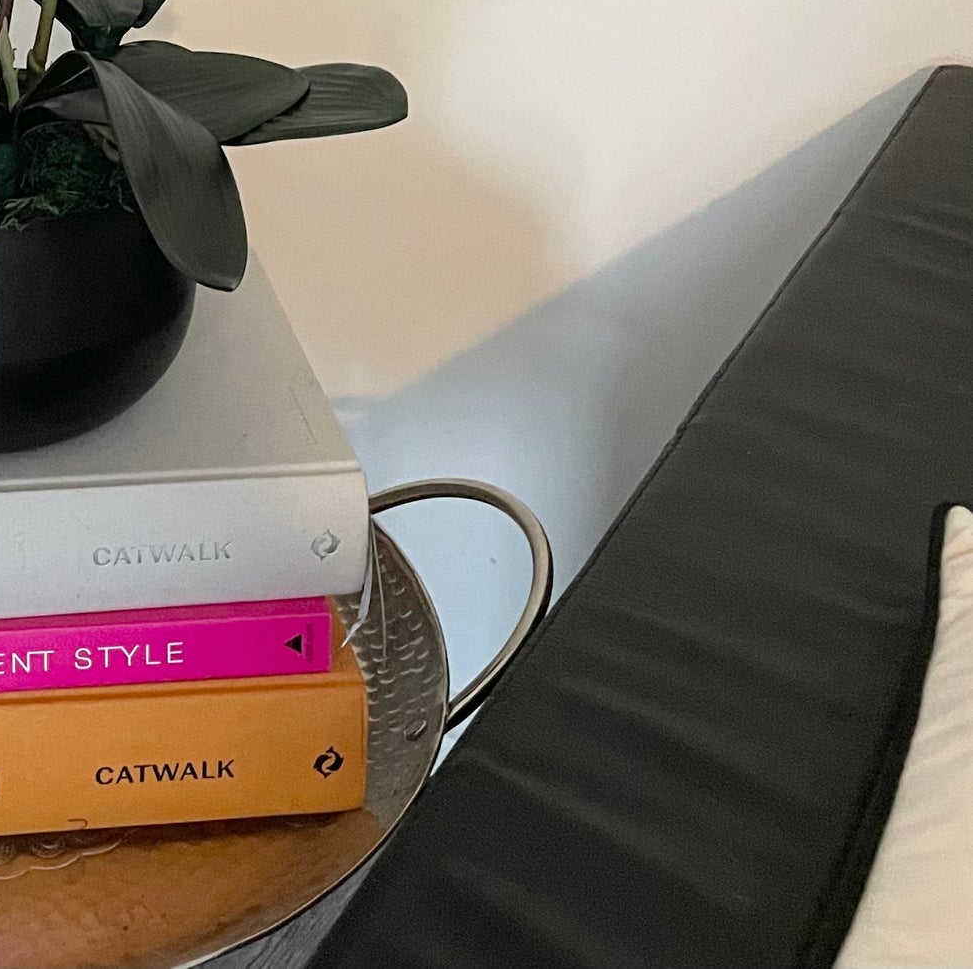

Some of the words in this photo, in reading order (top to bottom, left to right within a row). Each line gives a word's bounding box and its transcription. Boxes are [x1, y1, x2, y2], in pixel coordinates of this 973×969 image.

[92, 540, 232, 567] CATWALK
[74, 641, 185, 671] STYLE
[95, 759, 236, 786] CATWALK
